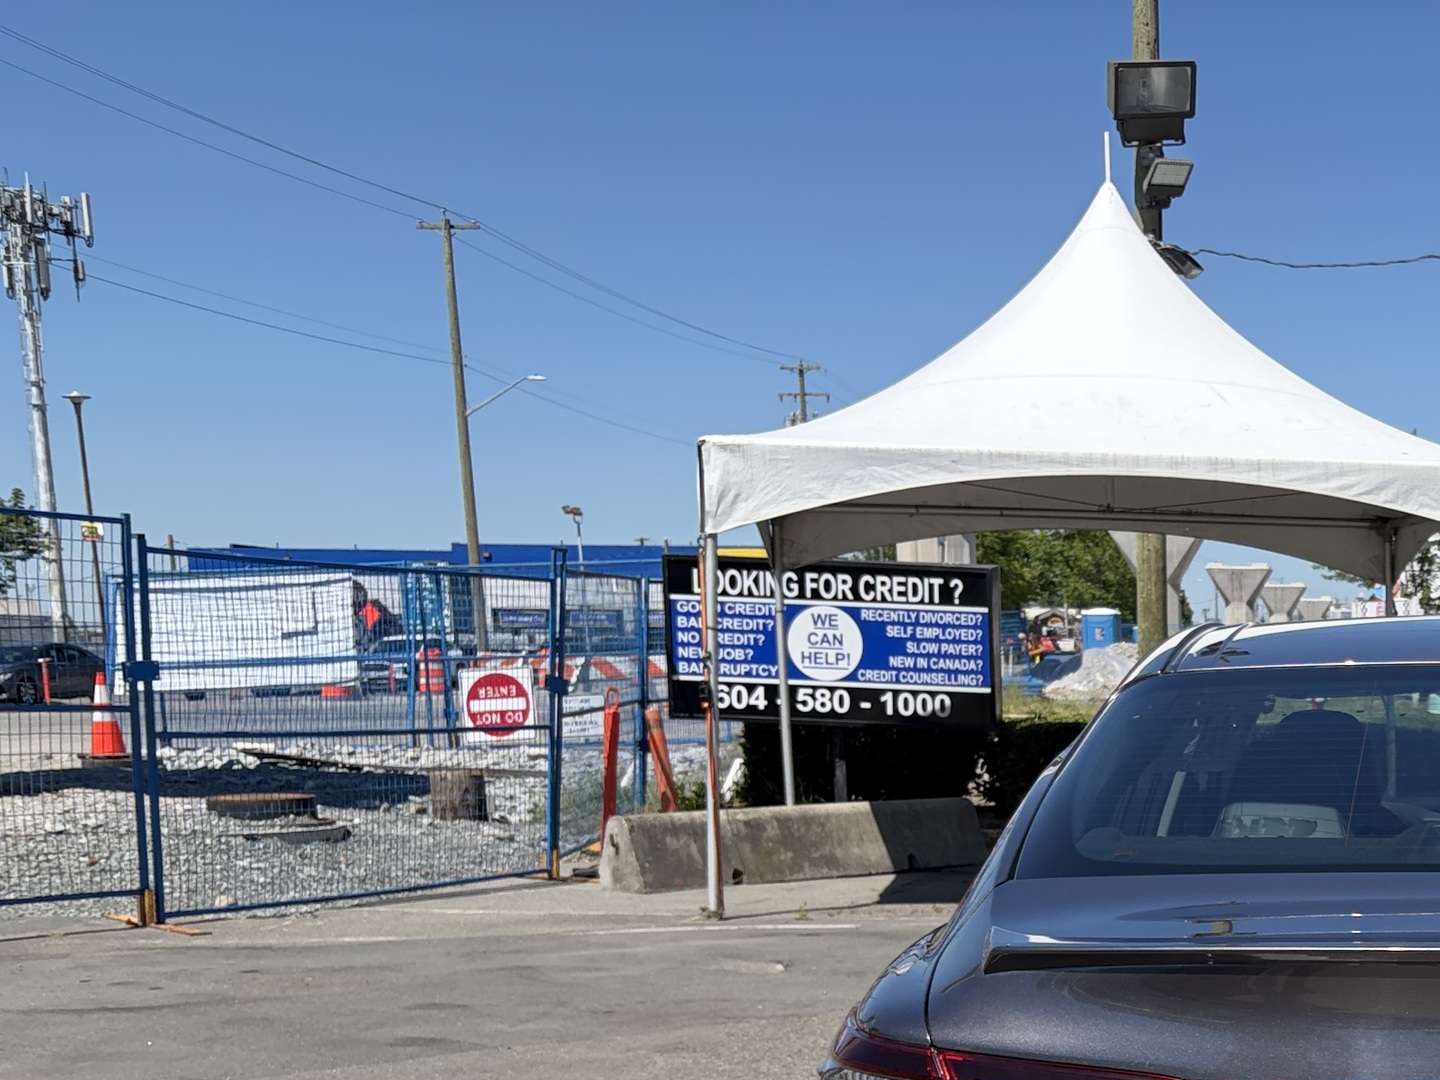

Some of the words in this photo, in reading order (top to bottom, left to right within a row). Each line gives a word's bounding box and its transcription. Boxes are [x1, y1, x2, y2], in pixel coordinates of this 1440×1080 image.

[804, 572, 854, 600] FOR
[858, 574, 944, 604] CREDIT
[811, 613, 839, 627] WE
[860, 609, 917, 623] RECENTLY
[919, 612, 983, 626] DIVORCED?
[678, 631, 700, 644] NO
[717, 633, 765, 646] REDIT?
[807, 632, 844, 647] CAN
[886, 625, 914, 638] SELF
[916, 627, 983, 641] EMPLOYED?
[906, 641, 939, 654] SLOW
[941, 643, 983, 657] PAYER?
[801, 651, 850, 667] HELP!
[888, 656, 915, 668] NEW
[917, 657, 927, 669] IN
[930, 658, 984, 671] CANADA?
[857, 669, 897, 682] CREDIT
[899, 672, 984, 686] COUNSELLING?
[477, 685, 516, 698] ENTER
[718, 684, 768, 710] 604
[795, 687, 851, 714] 580
[880, 691, 952, 717] 1000
[475, 712, 500, 725] NOT
[505, 711, 523, 724] DO
